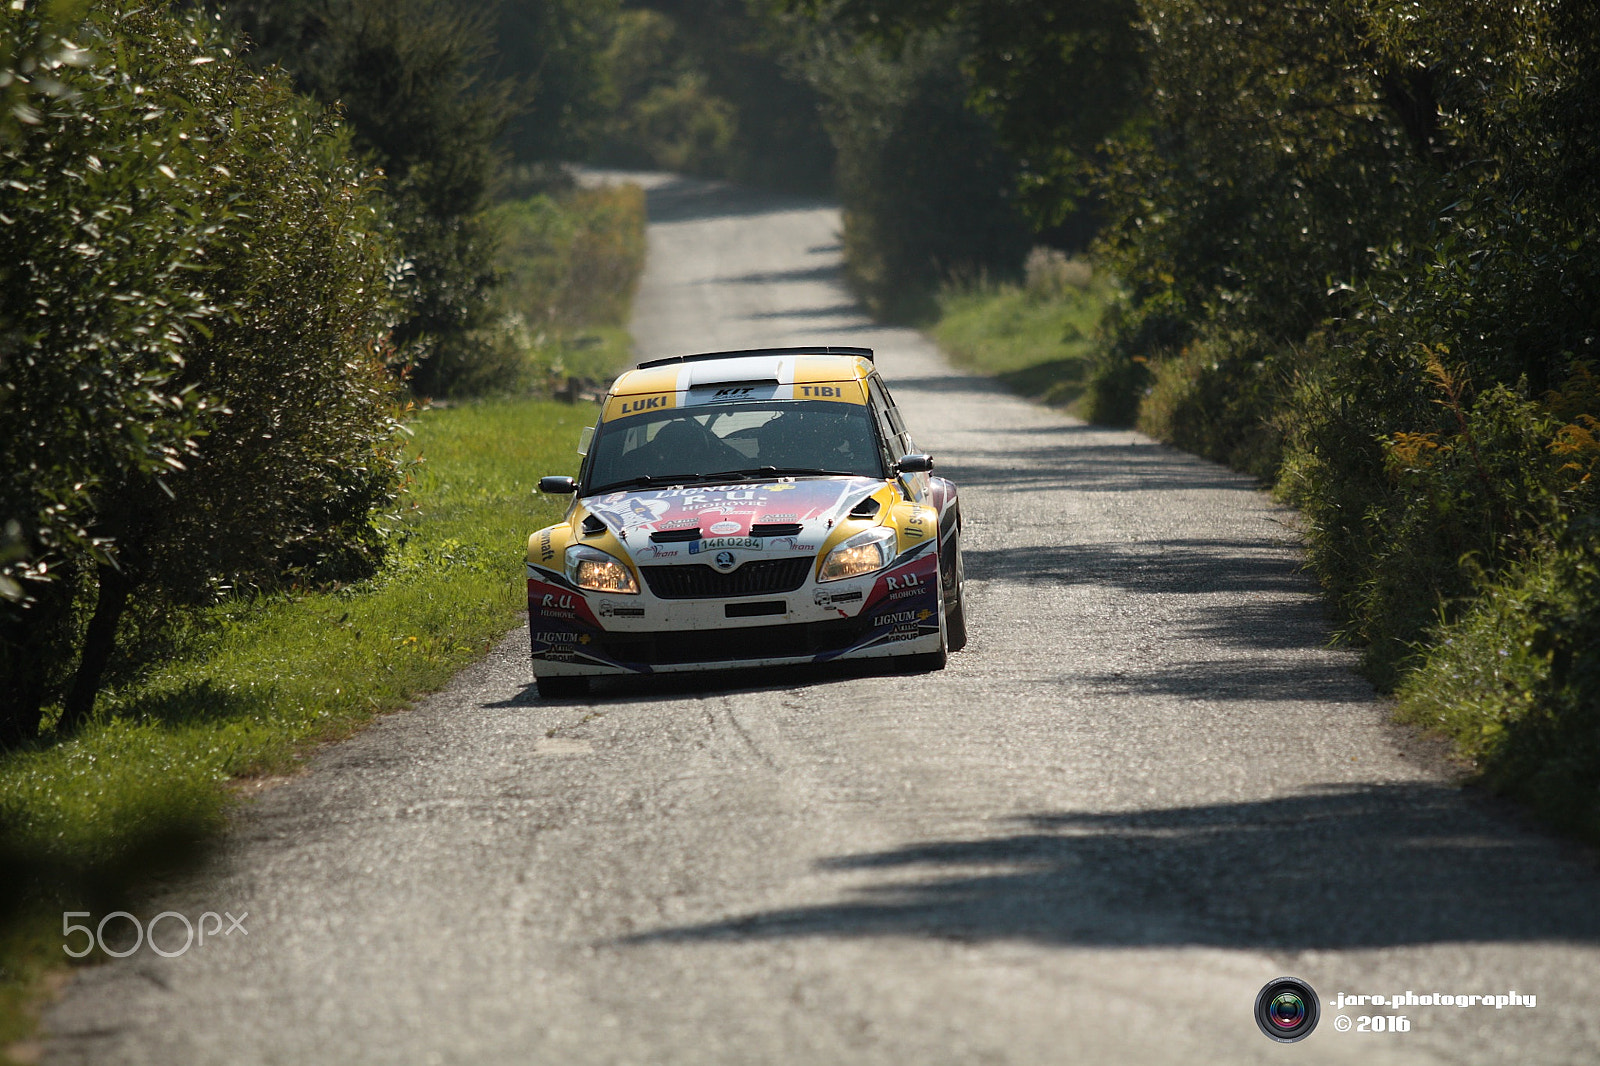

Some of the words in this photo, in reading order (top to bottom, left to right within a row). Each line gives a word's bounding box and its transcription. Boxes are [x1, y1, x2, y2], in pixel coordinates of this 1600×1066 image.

[715, 387, 755, 396] KIT
[800, 386, 841, 398] TIBI
[621, 396, 667, 414] LUKI
[683, 491, 767, 505] R.U.
[702, 539, 725, 550] 14R
[727, 537, 760, 549] 0284
[886, 573, 924, 591] R.U.
[889, 588, 927, 600] HLOHOVEC
[542, 593, 575, 609] R.U.
[540, 609, 576, 619] HLOHOVEC
[874, 610, 916, 627] LIGNUM
[536, 632, 578, 642] LIGNUM
